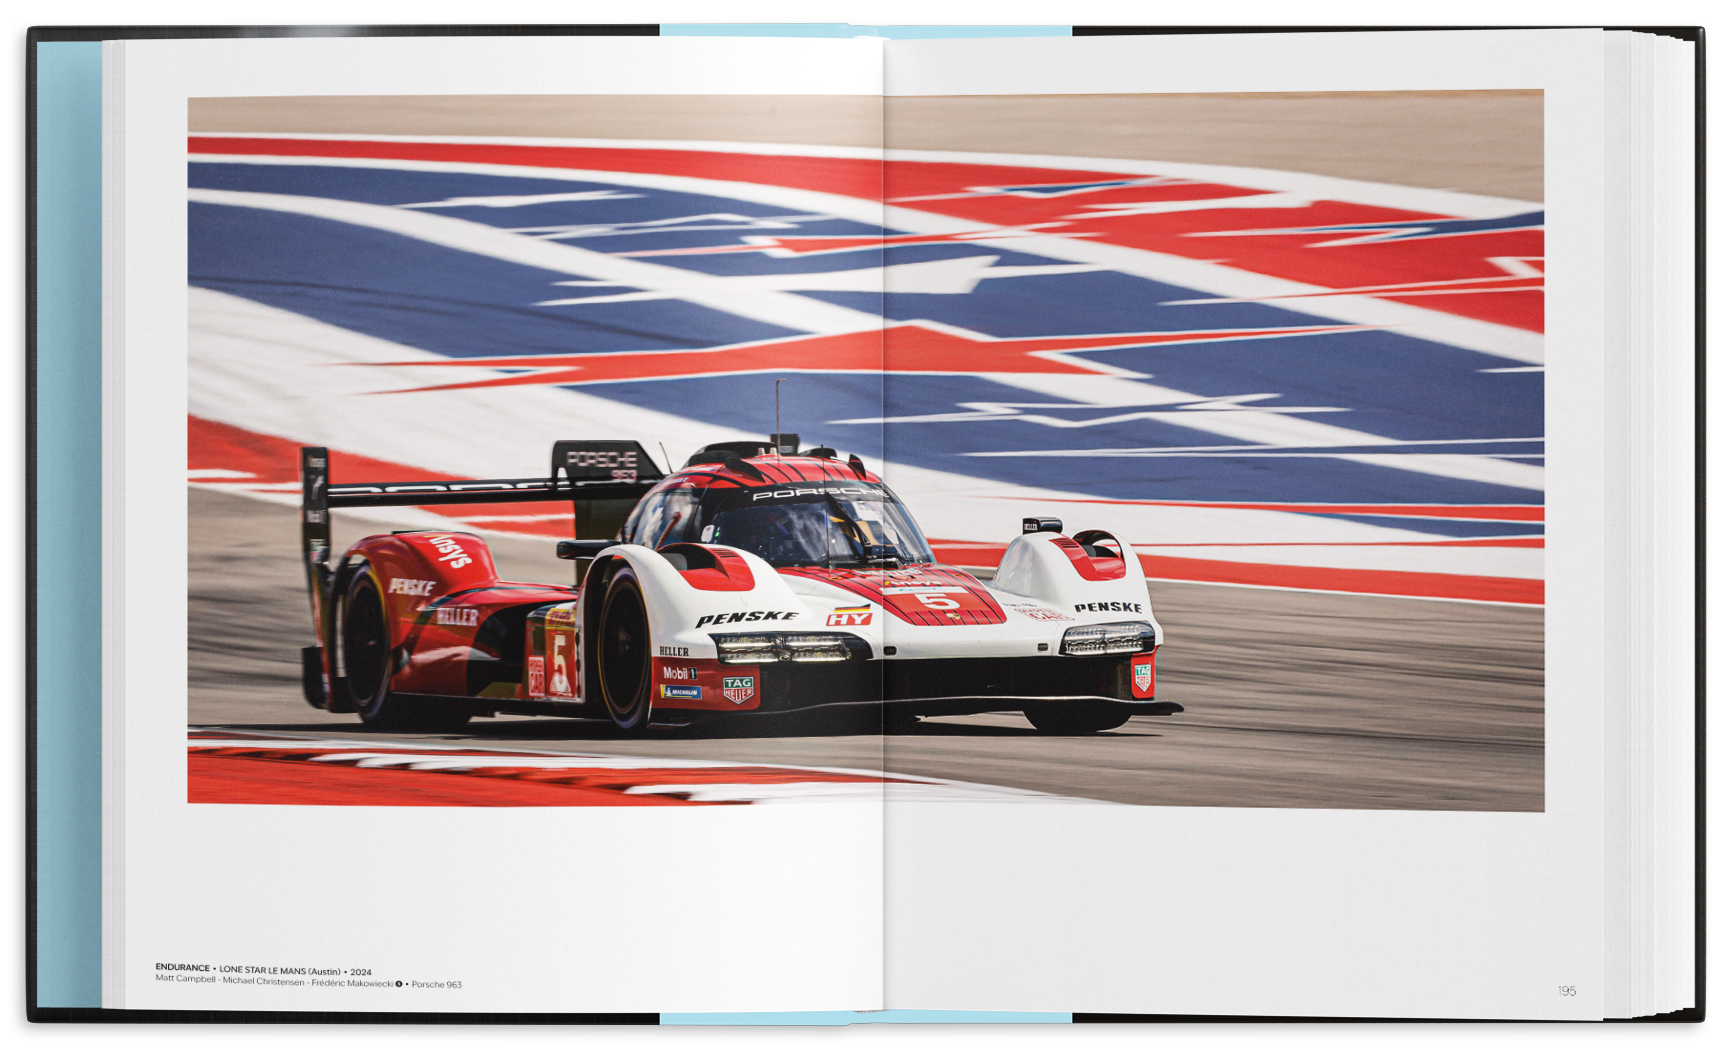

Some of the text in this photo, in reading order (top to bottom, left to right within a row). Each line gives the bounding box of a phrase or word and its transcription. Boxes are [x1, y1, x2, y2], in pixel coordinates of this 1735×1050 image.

[567, 451, 637, 467] PORSCHE
[753, 487, 889, 501] PORSCHE
[388, 578, 437, 596] PENSKE
[914, 594, 961, 609] 5
[1074, 601, 1142, 614] PENSKE
[437, 607, 479, 626] HELLER
[695, 611, 800, 629] PENSKE
[828, 613, 869, 626] HY
[660, 646, 689, 656] HELLER
[553, 634, 567, 693] 5
[1136, 666, 1150, 675] TAG
[663, 666, 688, 680] Mobil
[725, 679, 751, 688] TAG
[725, 688, 752, 701] HEUER
[155, 963, 372, 976] ENDURANCE LONE STAR LE MANS (Austin) 2024
[176, 974, 216, 983] Campbell
[223, 976, 254, 985] Michael
[256, 977, 305, 986] Christensen
[312, 979, 345, 987] Frédéric
[347, 980, 394, 988] Makowiecki
[412, 981, 444, 989] Porsche
[446, 981, 462, 989] 963
[1558, 985, 1577, 996] 195
